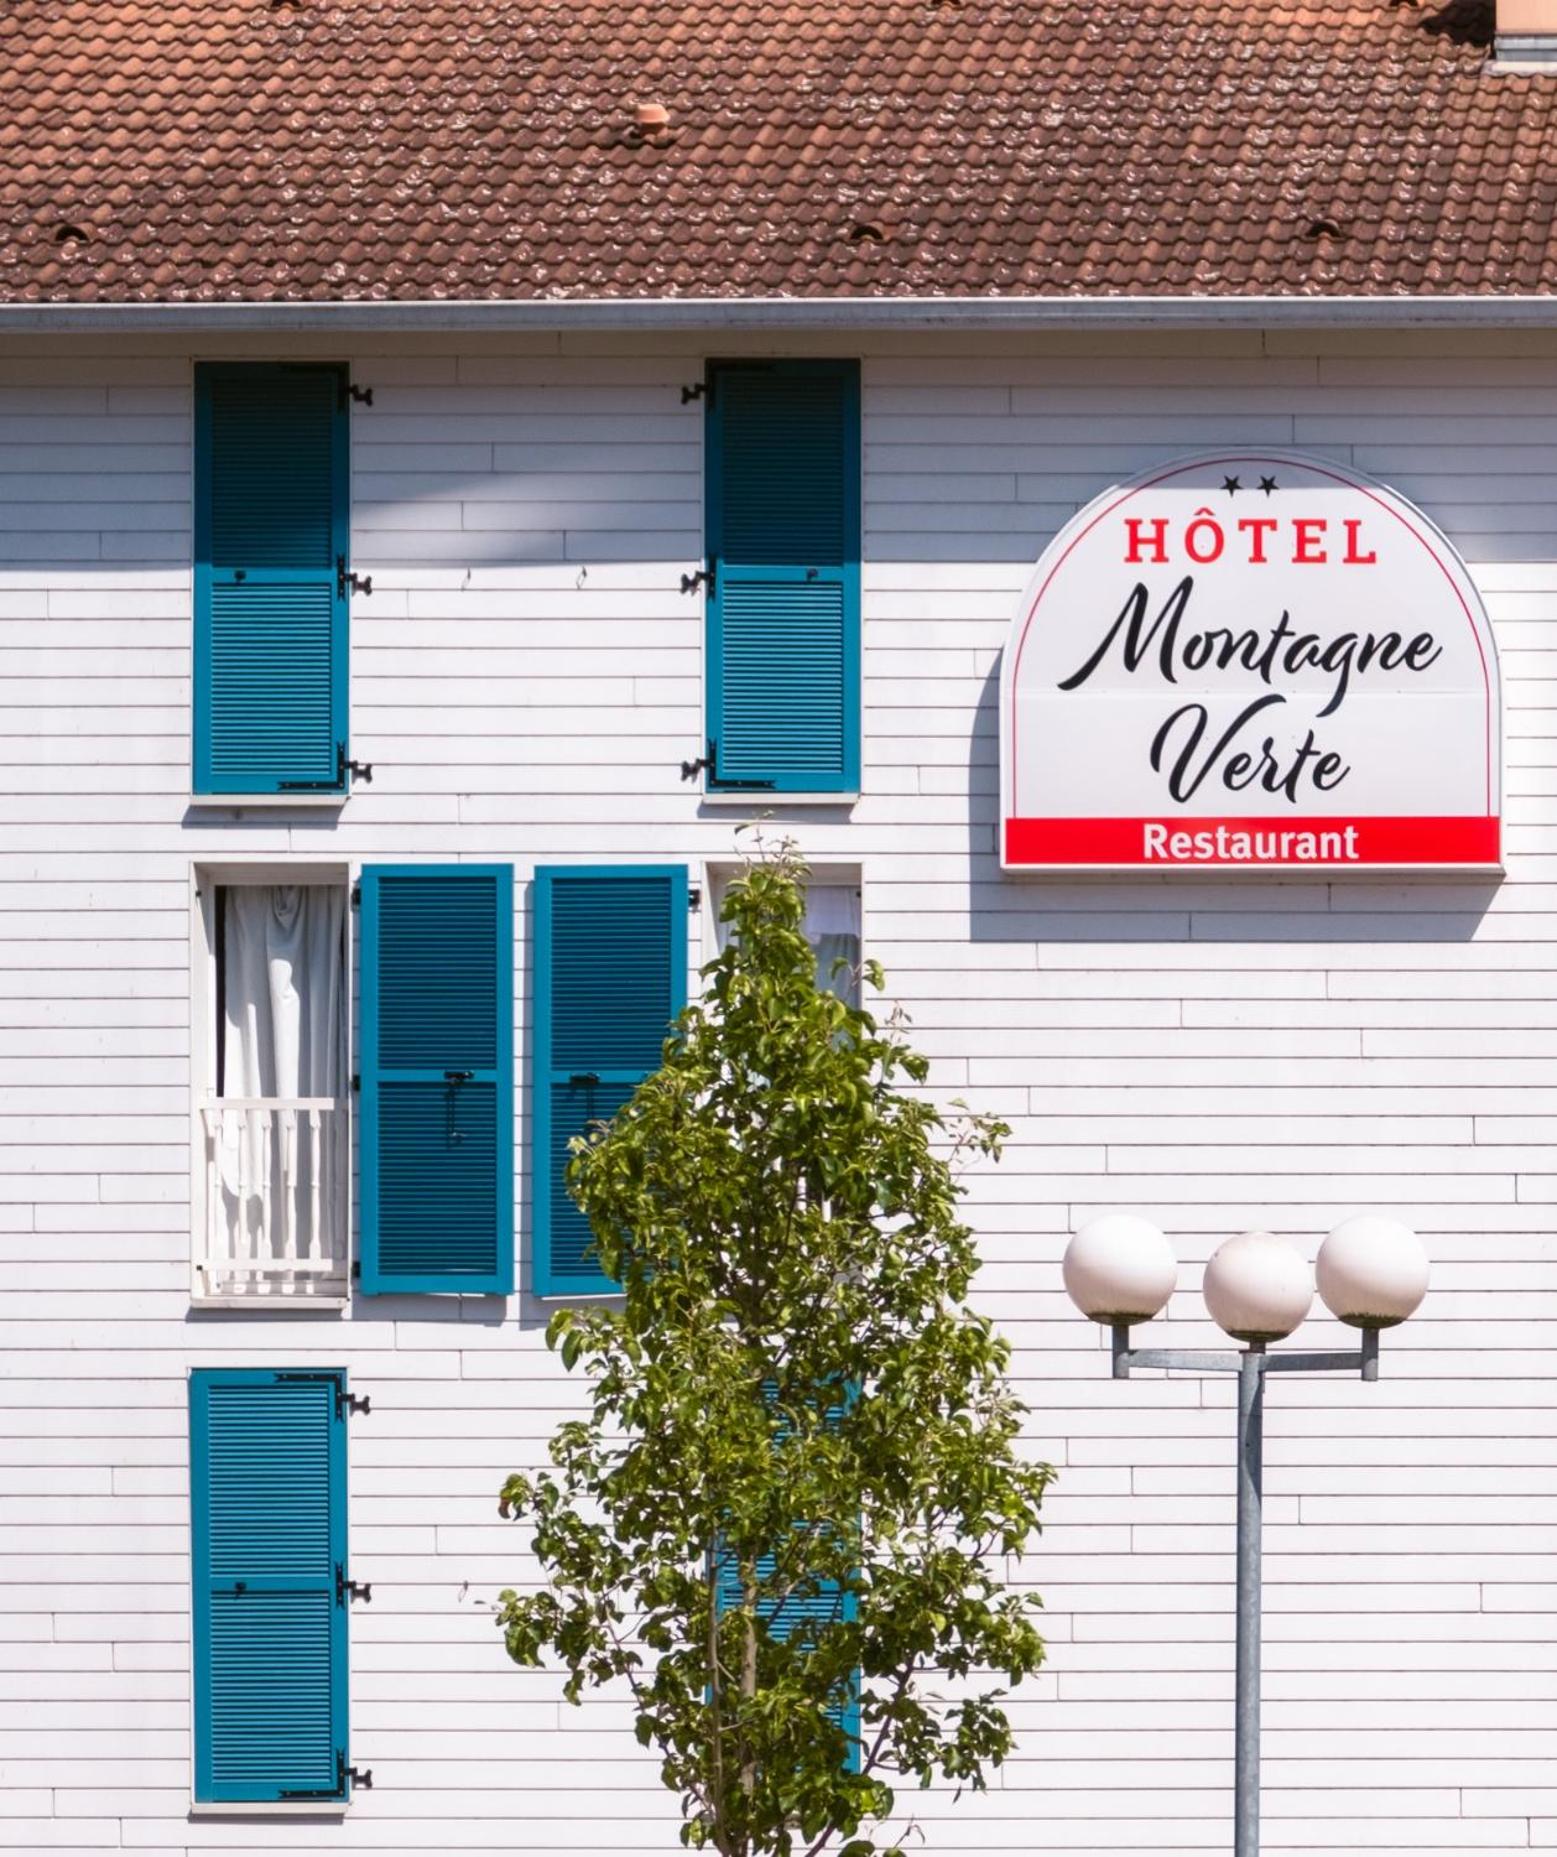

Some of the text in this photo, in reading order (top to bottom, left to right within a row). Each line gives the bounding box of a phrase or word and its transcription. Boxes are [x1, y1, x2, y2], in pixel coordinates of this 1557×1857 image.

[1123, 507, 1377, 564] HÔTEL
[1057, 575, 1443, 718] Montagne
[1149, 693, 1351, 804] Verte
[1143, 823, 1359, 860] Restaurant
